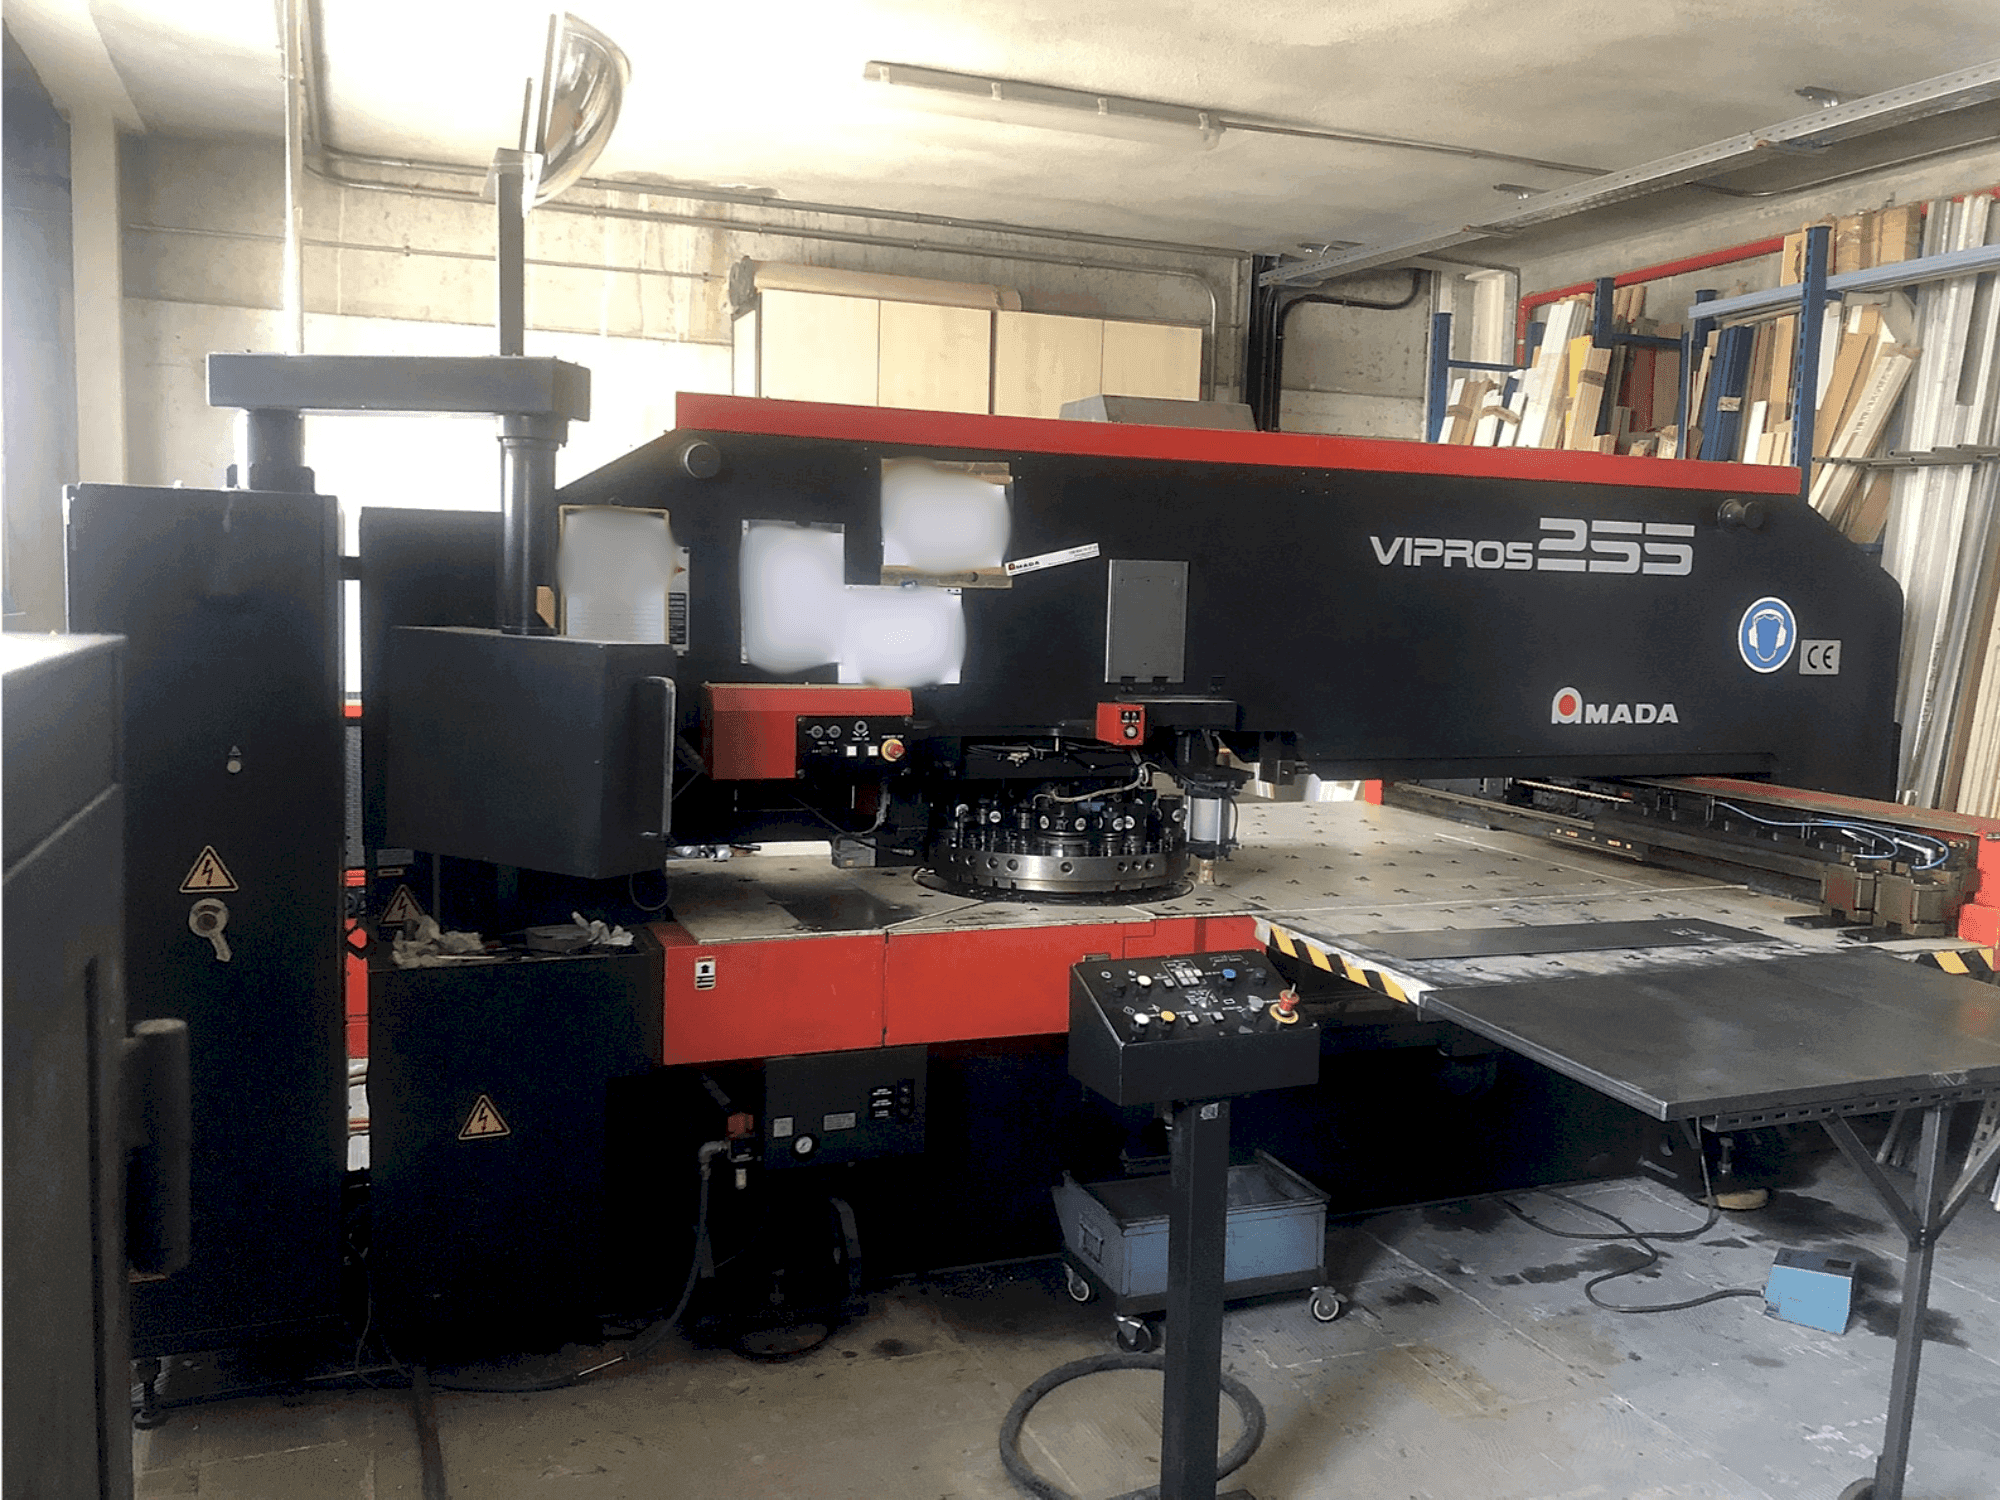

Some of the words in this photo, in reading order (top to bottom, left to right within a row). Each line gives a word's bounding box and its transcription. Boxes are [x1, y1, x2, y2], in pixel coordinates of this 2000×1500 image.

[1370, 536, 1533, 571] VIPROS
[1537, 517, 1695, 576] 255
[1807, 644, 1835, 670] CE
[1551, 686, 1679, 725] AMADA
